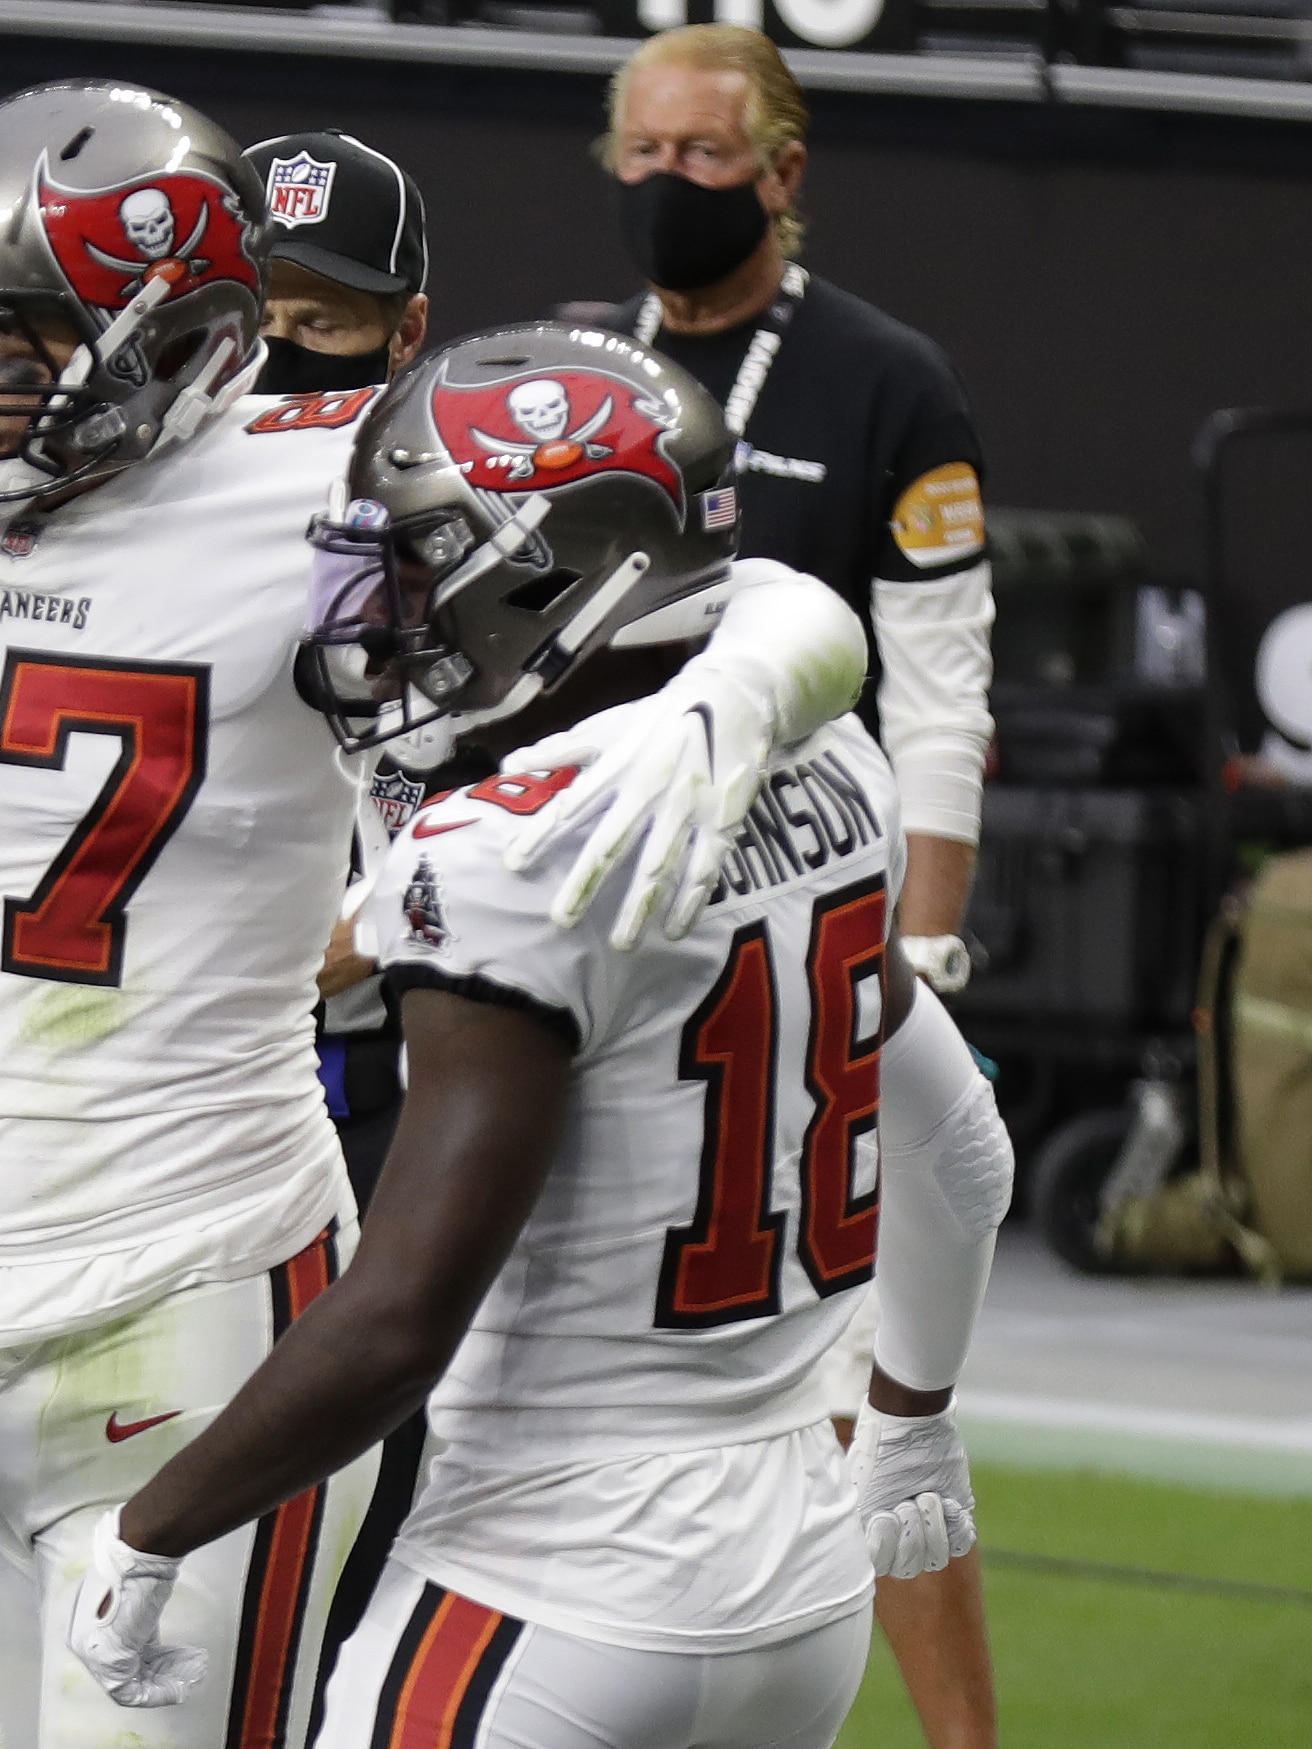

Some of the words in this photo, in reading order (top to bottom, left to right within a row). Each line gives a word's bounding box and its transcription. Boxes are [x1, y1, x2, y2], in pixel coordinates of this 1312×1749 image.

[272, 186, 320, 217] NFL
[242, 385, 381, 435] 8
[418, 764, 582, 816] 8
[708, 749, 885, 905] HNSON
[653, 868, 887, 1329] 18
